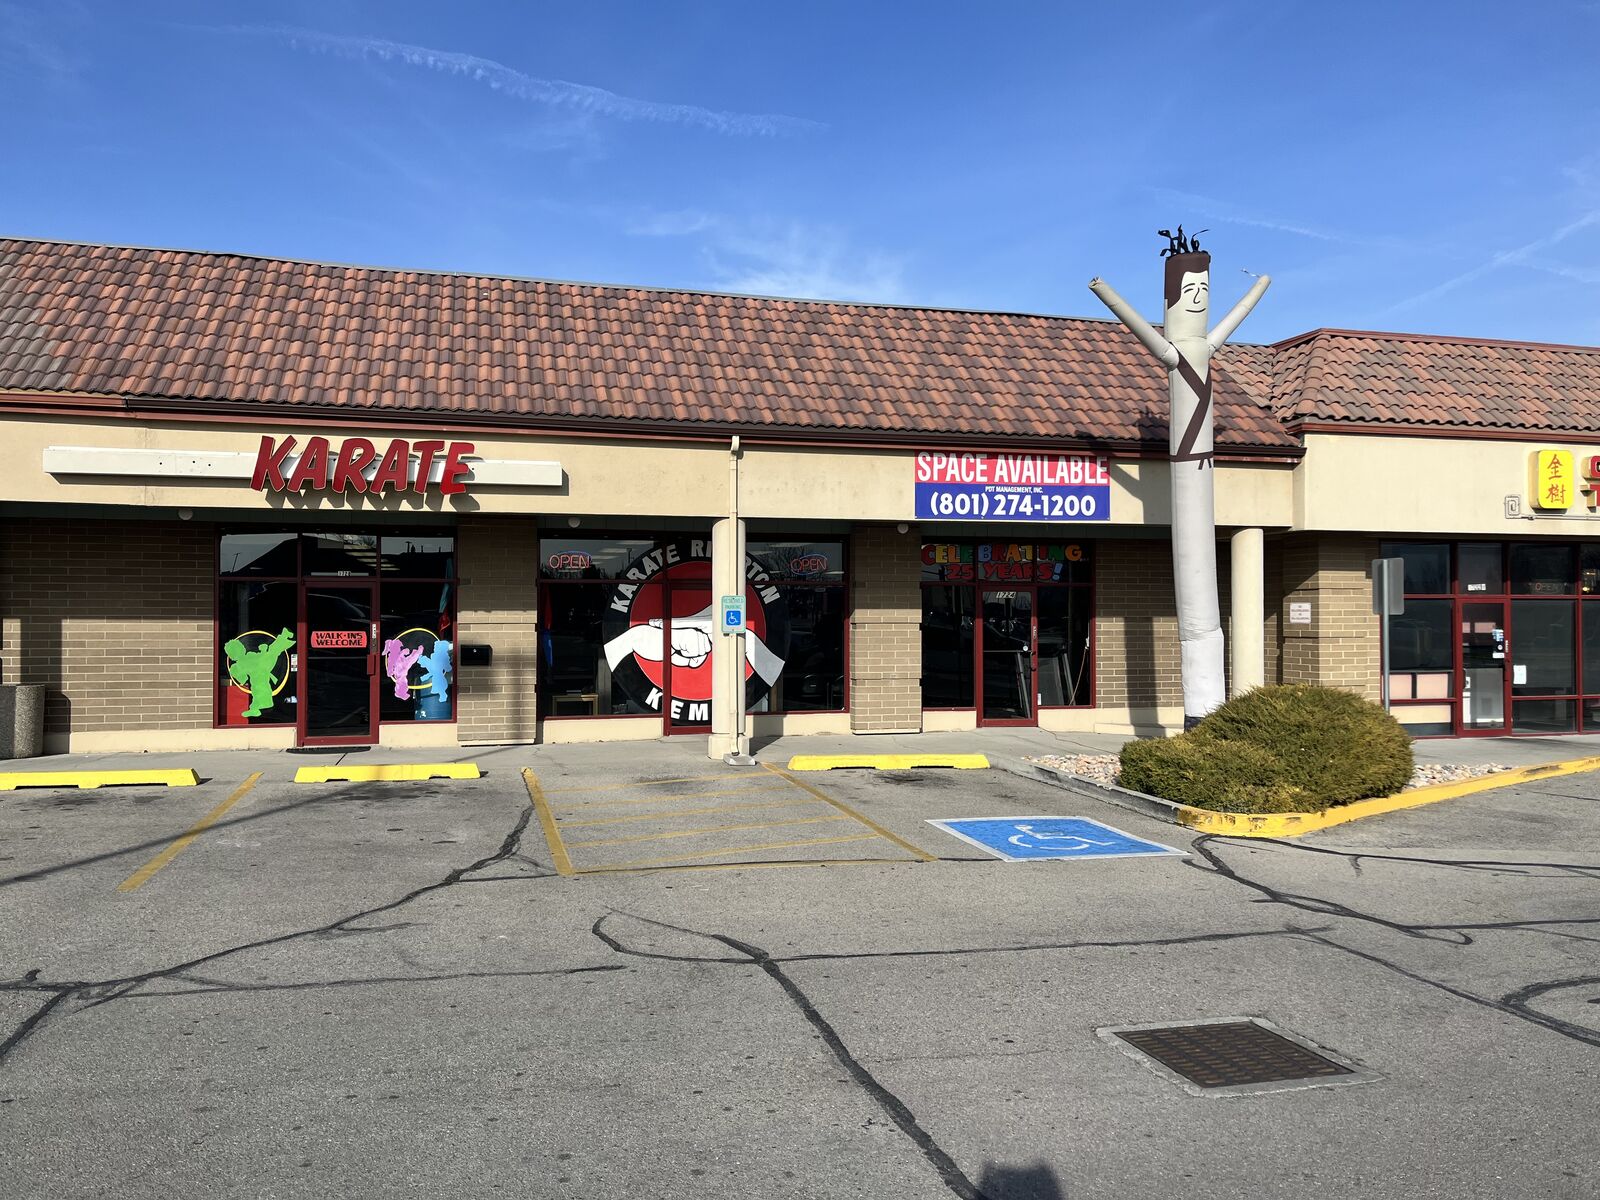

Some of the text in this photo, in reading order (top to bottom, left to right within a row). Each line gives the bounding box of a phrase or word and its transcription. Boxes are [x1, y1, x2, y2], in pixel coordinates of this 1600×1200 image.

[250, 434, 476, 496] KARATE
[916, 452, 1109, 485] SPACE AVAILABLE
[930, 491, 1096, 517] (801) 274-1200
[548, 554, 591, 569] OPEN
[691, 539, 780, 605] RITON
[790, 557, 828, 573] OPEN
[945, 562, 1063, 581] 25 YEARS!
[610, 543, 680, 614] KARATE
[996, 591, 1017, 599] 1724
[645, 687, 709, 722] KEM
